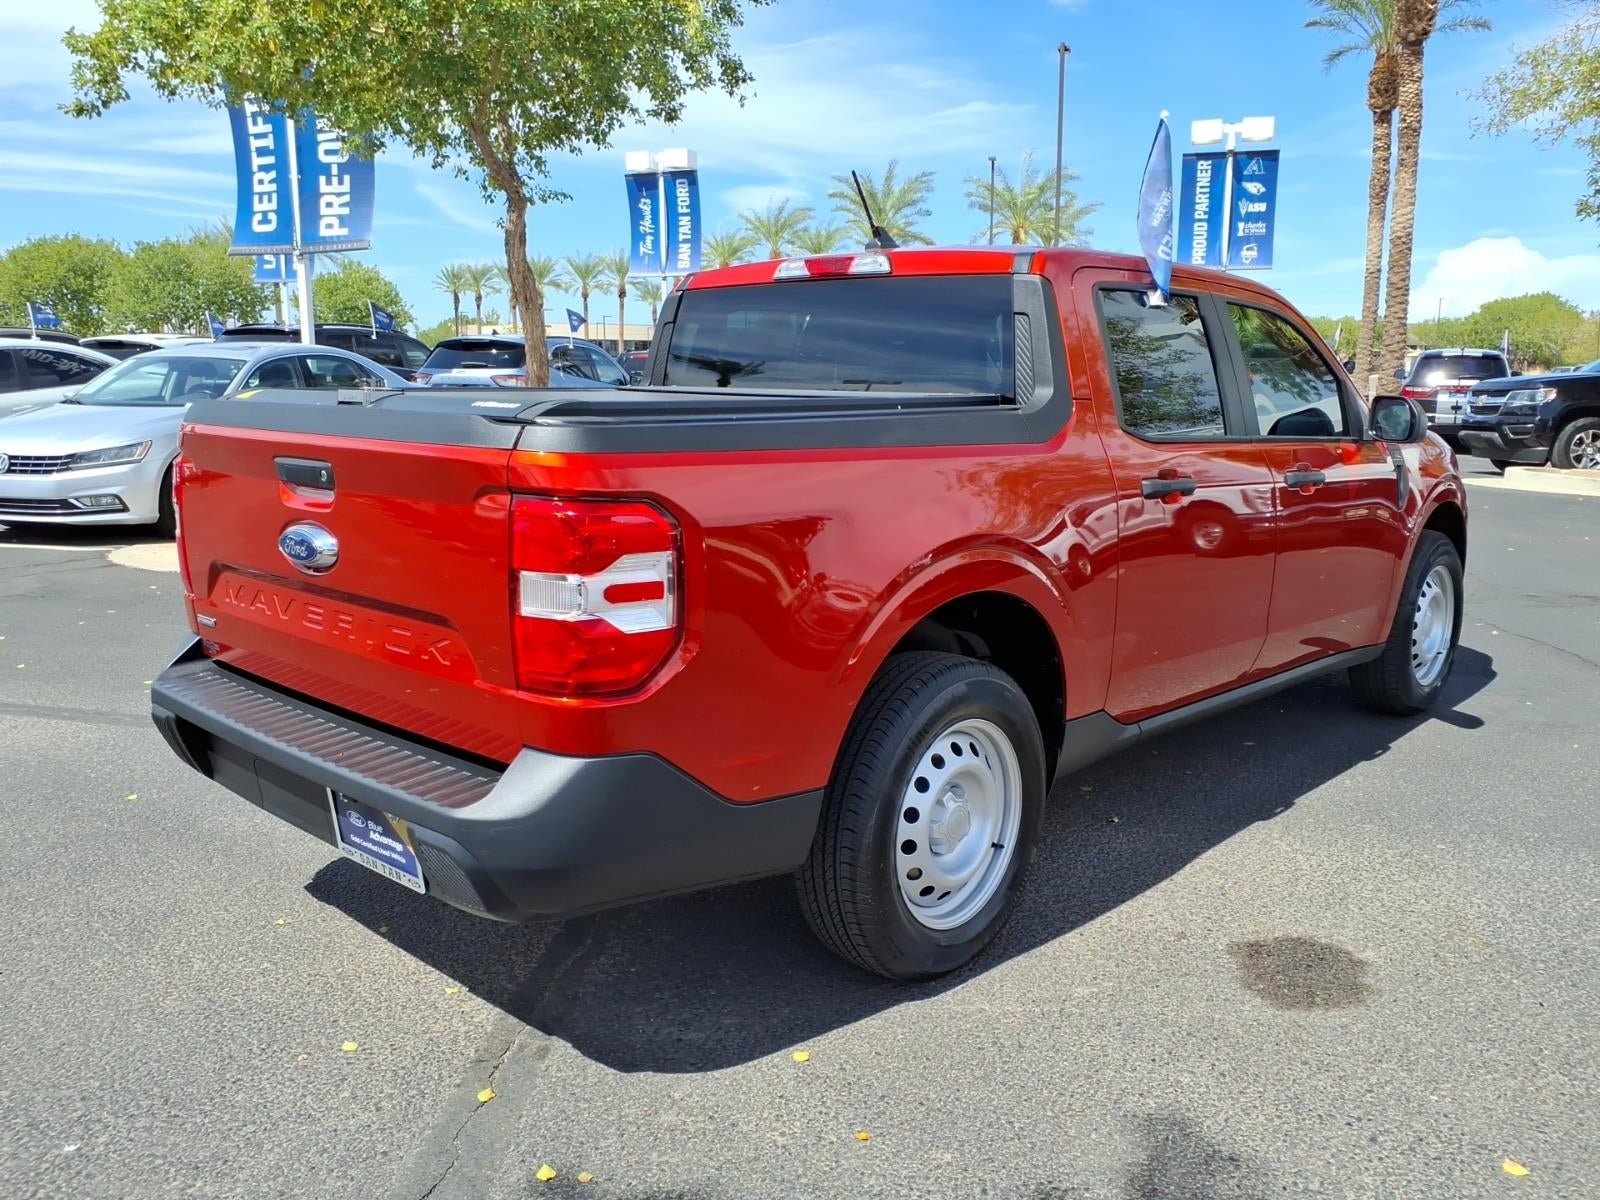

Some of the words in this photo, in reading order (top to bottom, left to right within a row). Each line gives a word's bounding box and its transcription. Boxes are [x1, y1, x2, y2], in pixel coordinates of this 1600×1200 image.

[676, 179, 691, 214] FORD
[1194, 160, 1212, 219] PARTNER
[678, 216, 692, 242] TAN
[1191, 220, 1208, 264] PROUD
[639, 235, 655, 257] Tim
[677, 243, 692, 269] SAN
[284, 534, 309, 558] Ford
[224, 580, 452, 667] MAVERICK
[359, 852, 379, 870] SAN
[380, 862, 402, 881] TAN
